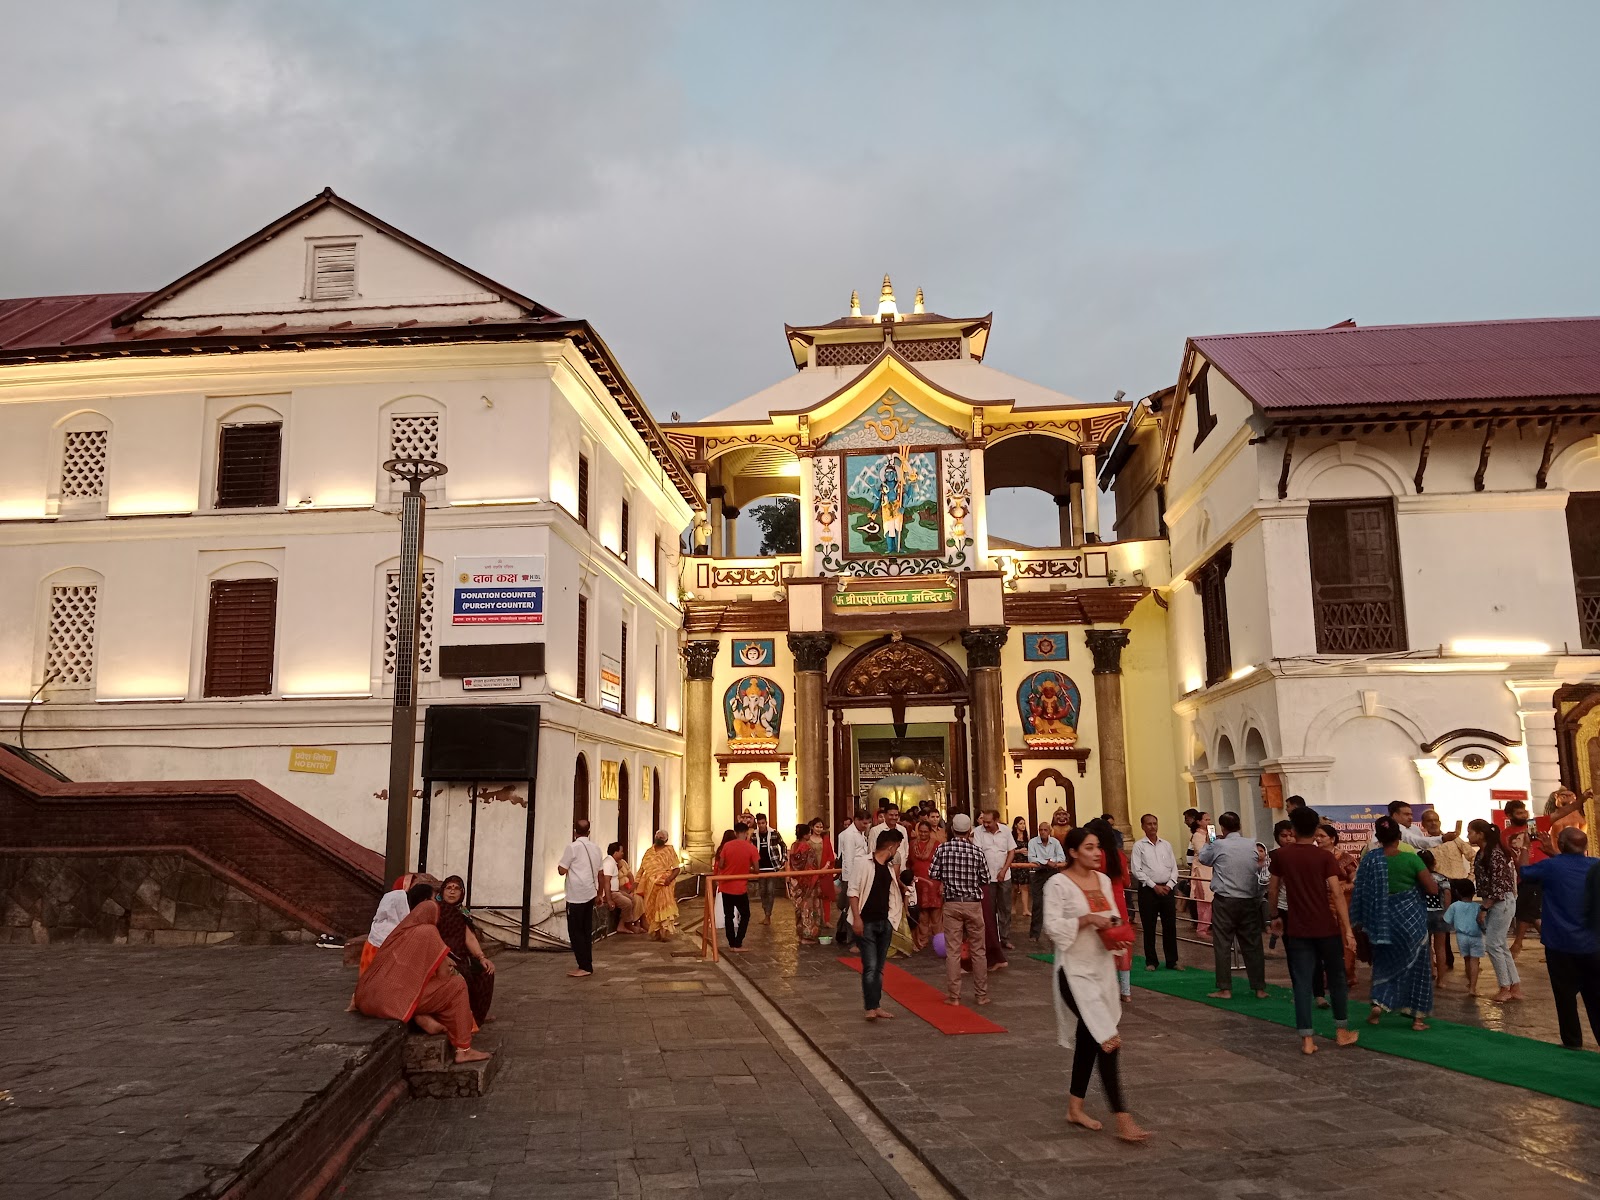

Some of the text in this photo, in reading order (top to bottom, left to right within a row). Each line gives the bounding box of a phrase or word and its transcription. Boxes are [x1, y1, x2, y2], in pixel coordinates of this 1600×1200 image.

[473, 573, 518, 583] दान कक्ष
[912, 589, 943, 603] मन्दिर
[462, 602, 495, 610] (PURCHY
[307, 761, 329, 769] ENTRY
